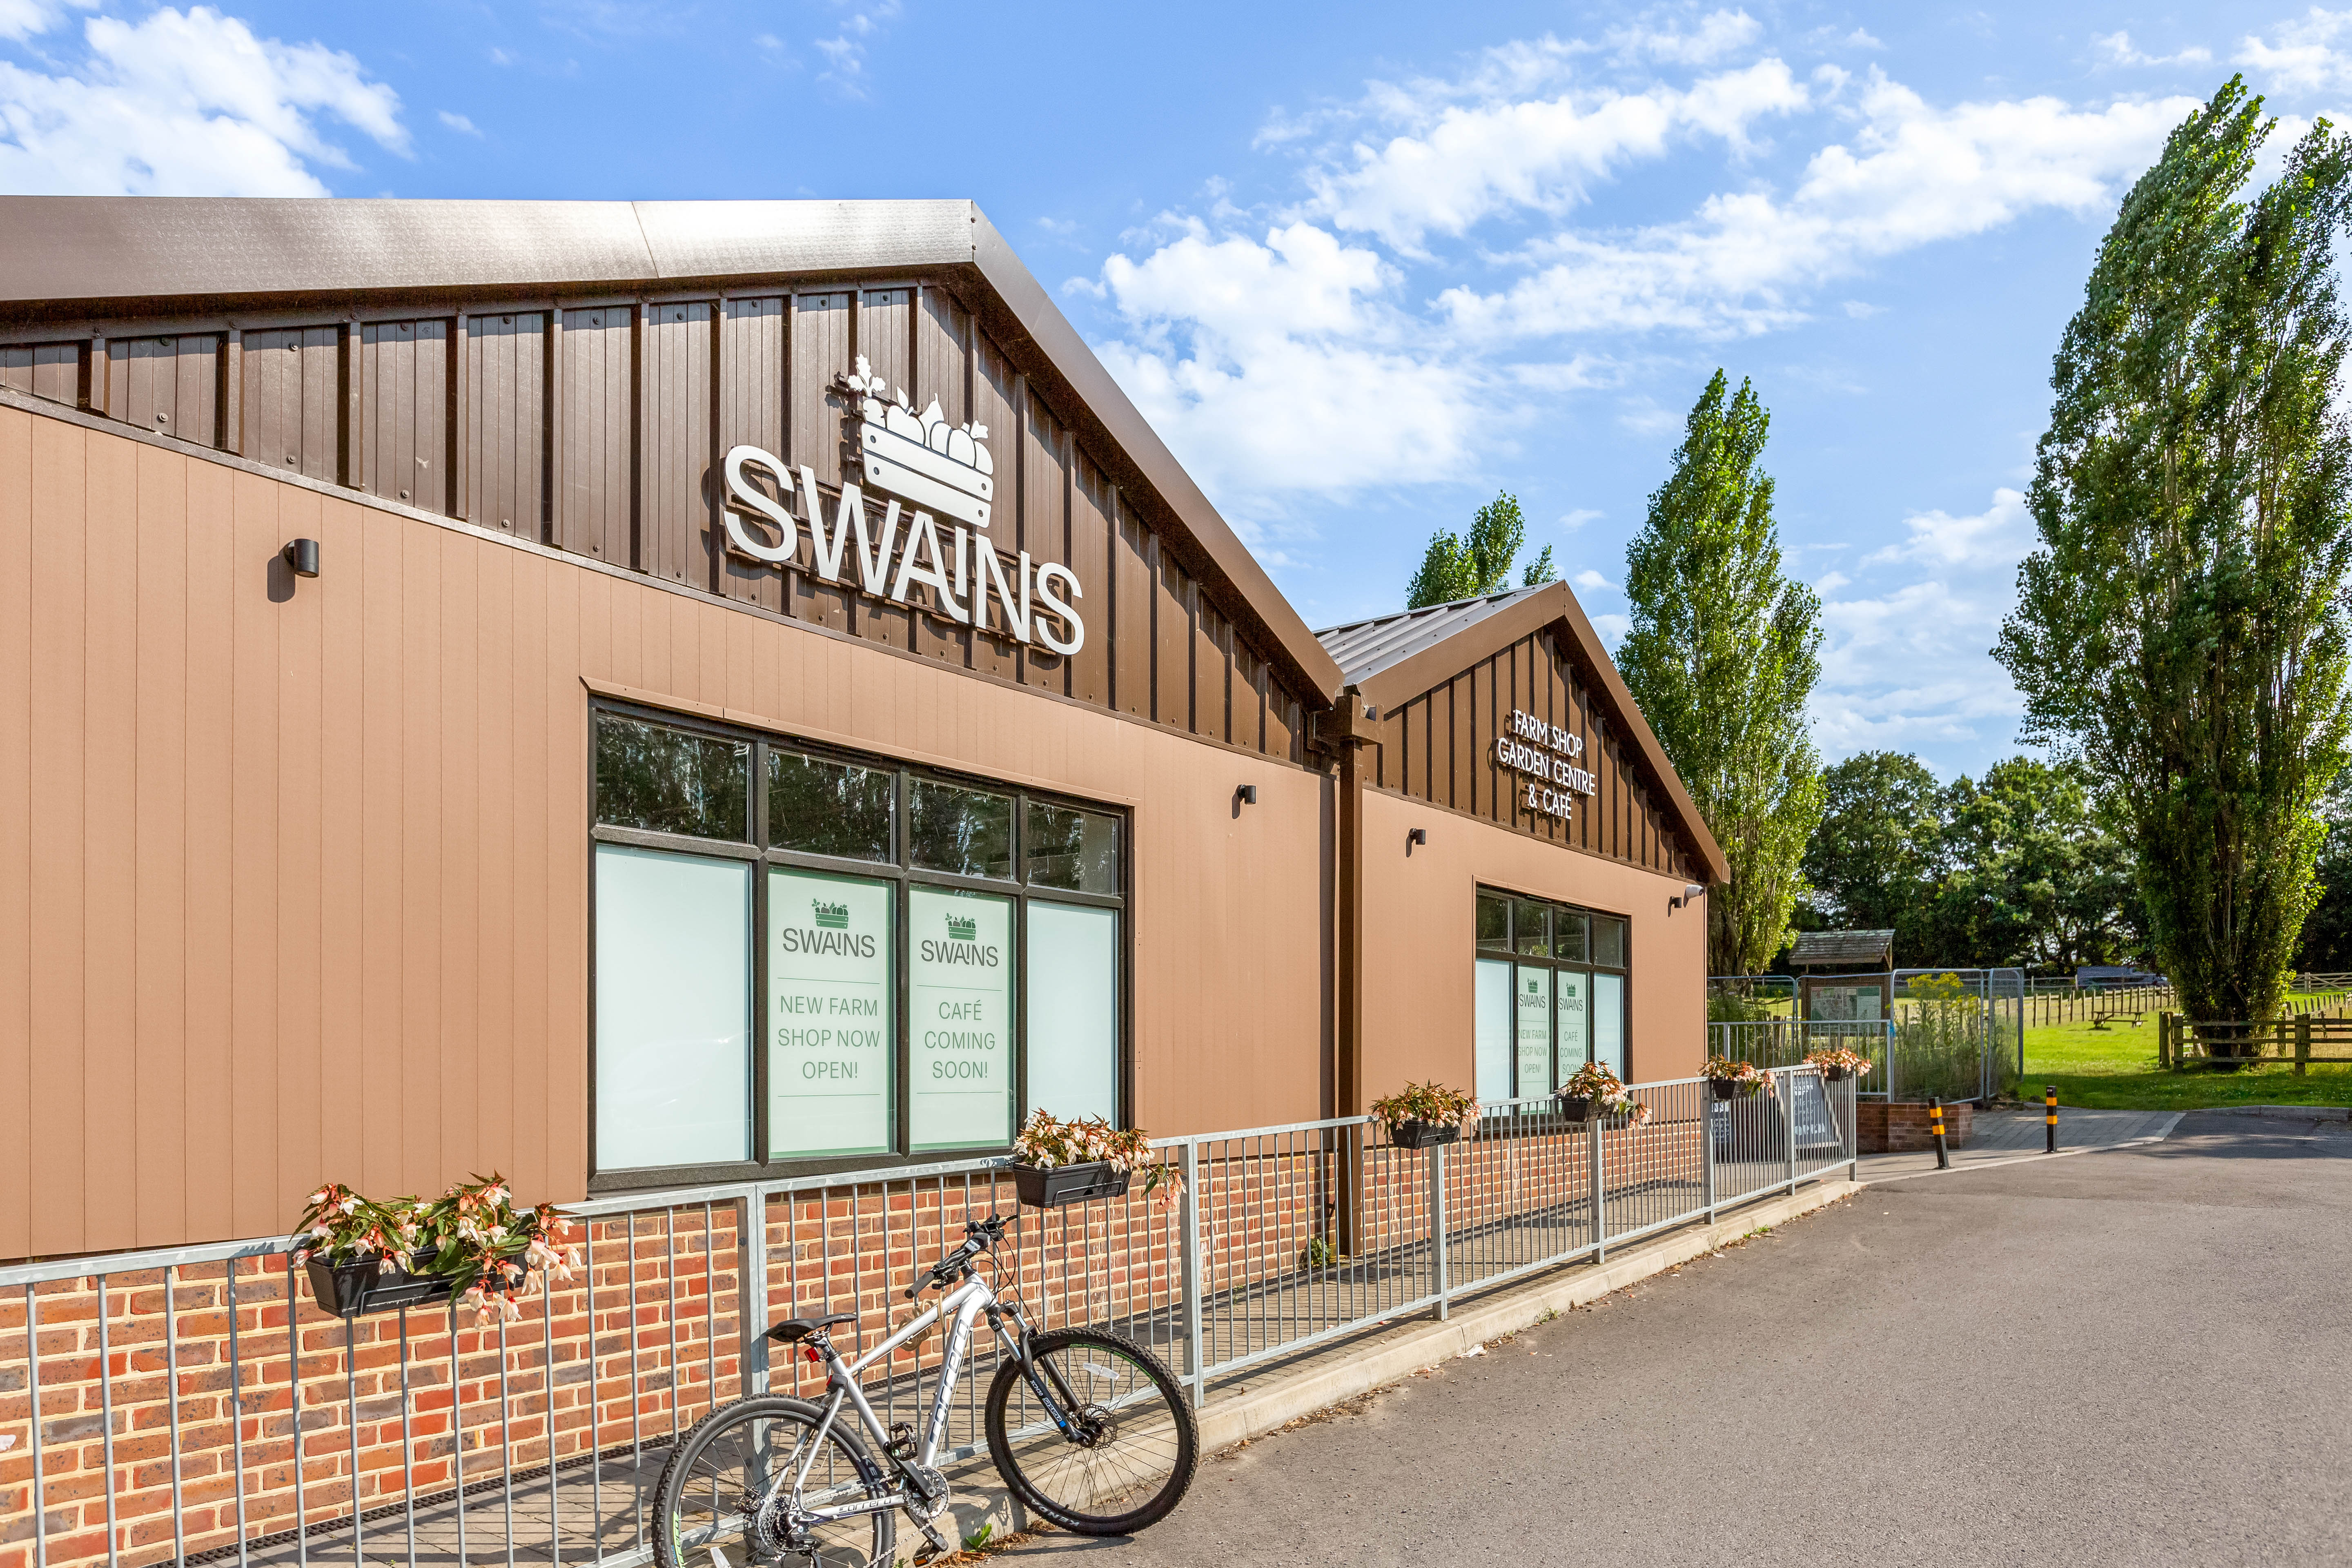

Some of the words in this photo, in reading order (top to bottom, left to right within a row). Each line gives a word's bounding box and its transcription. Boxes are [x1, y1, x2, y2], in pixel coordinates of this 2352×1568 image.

[724, 445, 1085, 655] SWAINS
[1515, 709, 1548, 745] FARM
[1552, 726, 1583, 759] SHOP
[1497, 737, 1549, 779] GARDEN
[1553, 760, 1595, 796] CENTRE
[1528, 783, 1537, 808] &
[1543, 788, 1572, 820] CAFÉ
[782, 928, 875, 958] SWAINS
[921, 940, 998, 967] SWAINS
[780, 995, 823, 1015] NEW
[829, 998, 878, 1016] FARM
[938, 999, 982, 1021] CAFÉ
[1519, 994, 1546, 1008] SWAINS
[1559, 998, 1583, 1011] SWAINS
[778, 1028, 832, 1047] SHOP
[837, 1030, 880, 1048] NOW
[924, 1031, 996, 1050] COMING
[1519, 1029, 1530, 1039] NEW
[1532, 1030, 1546, 1039] FARM
[1564, 1029, 1578, 1042] CAFÉ
[1518, 1047, 1533, 1056] SHOP
[1534, 1047, 1547, 1056] NOW
[1560, 1048, 1582, 1058] COMING
[802, 1061, 858, 1079] OPEN!
[932, 1060, 988, 1078] SOON!
[1524, 1064, 1541, 1074] OPEN!
[1030, 1380, 1044, 1396] XCM30
[1031, 1498, 1080, 1527] KENDA
